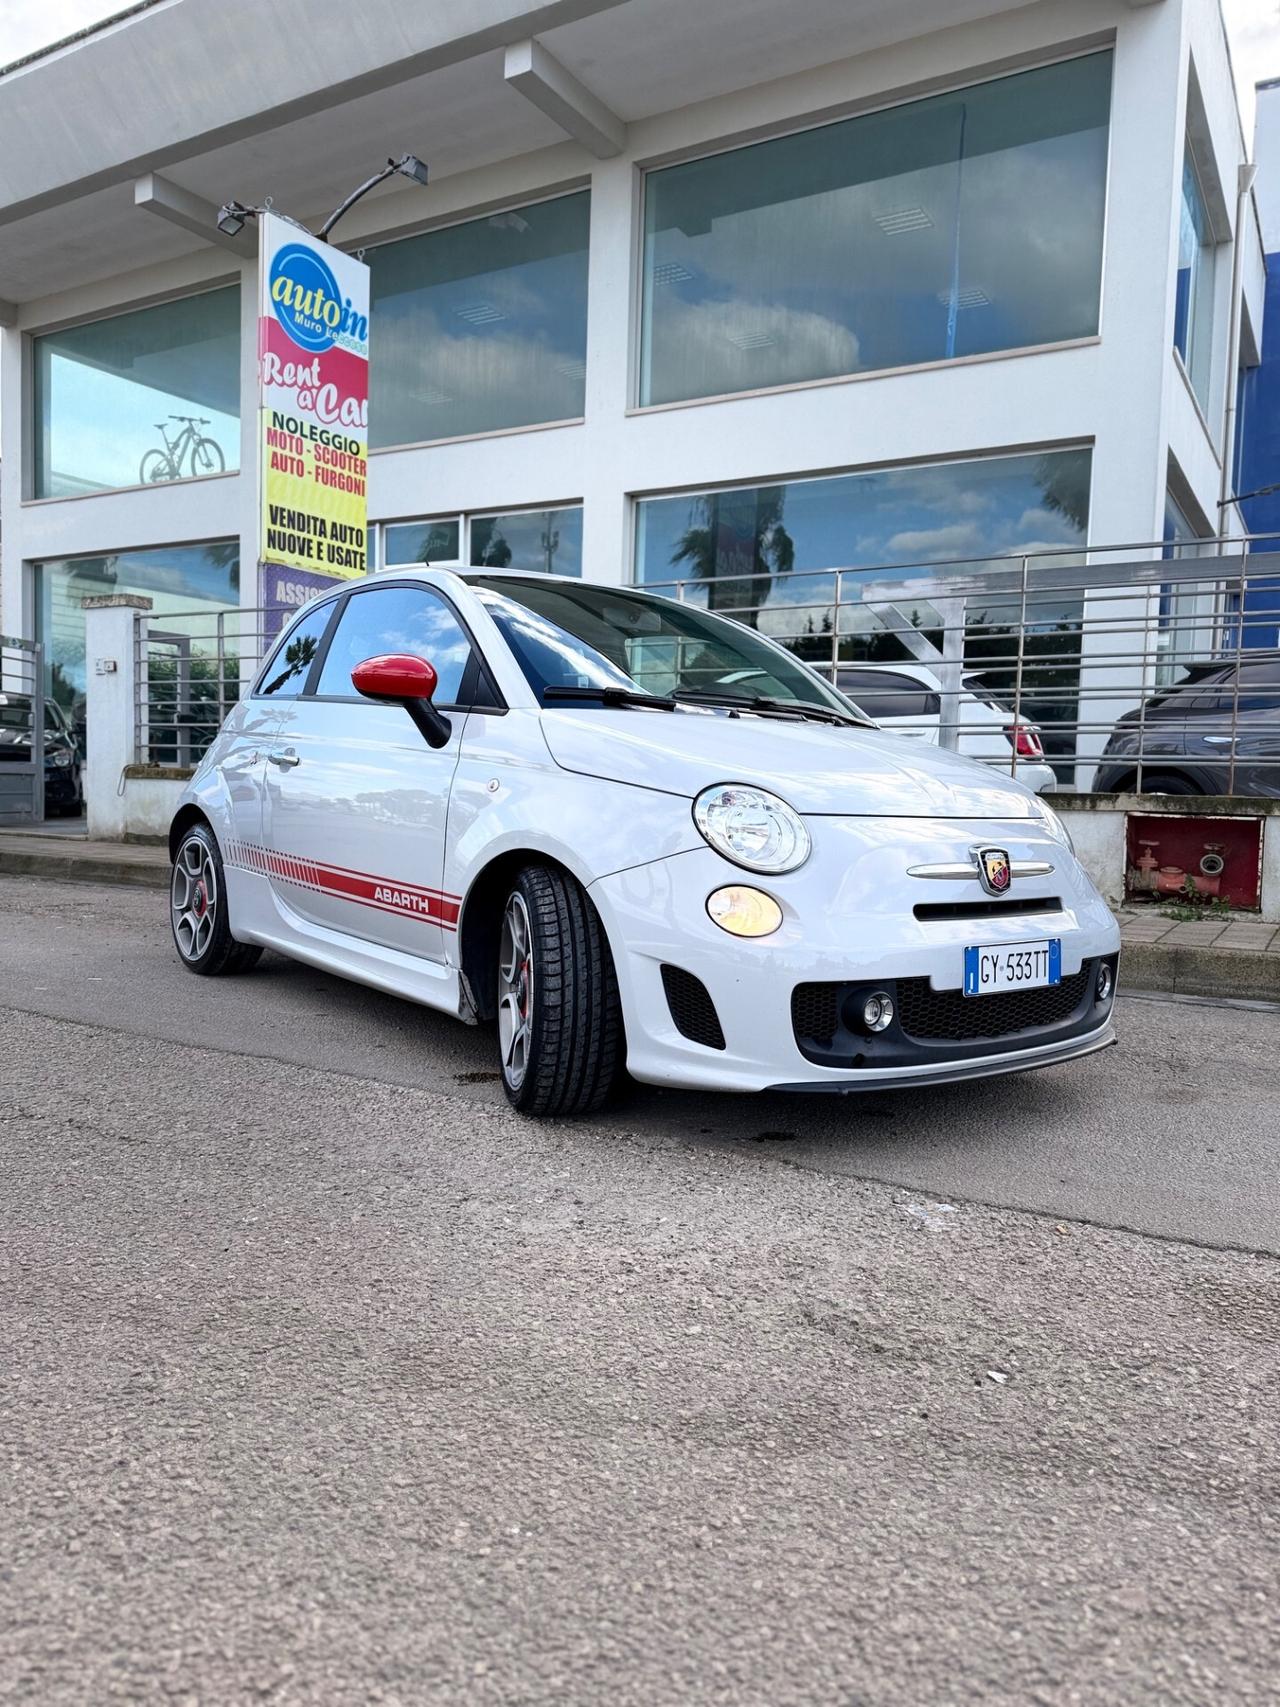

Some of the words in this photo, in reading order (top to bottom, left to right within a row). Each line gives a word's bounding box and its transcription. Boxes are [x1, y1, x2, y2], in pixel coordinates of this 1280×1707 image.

[294, 311, 322, 333] Muro
[263, 351, 321, 388] Rent
[267, 427, 304, 456] MOTO
[314, 443, 367, 477] SCOOTER
[272, 411, 360, 456] NOLEGGIO
[271, 451, 305, 477] AUTO
[315, 465, 366, 497] FURGONI
[269, 504, 327, 539] VENDITA
[329, 521, 364, 549] AUTO
[267, 528, 314, 559] NUOVE
[316, 541, 324, 561] E
[327, 543, 366, 571] USATE
[276, 580, 324, 606] ASSI
[374, 886, 429, 912] ABARTH
[981, 954, 999, 983] GY
[1006, 949, 1049, 981] 533TT
